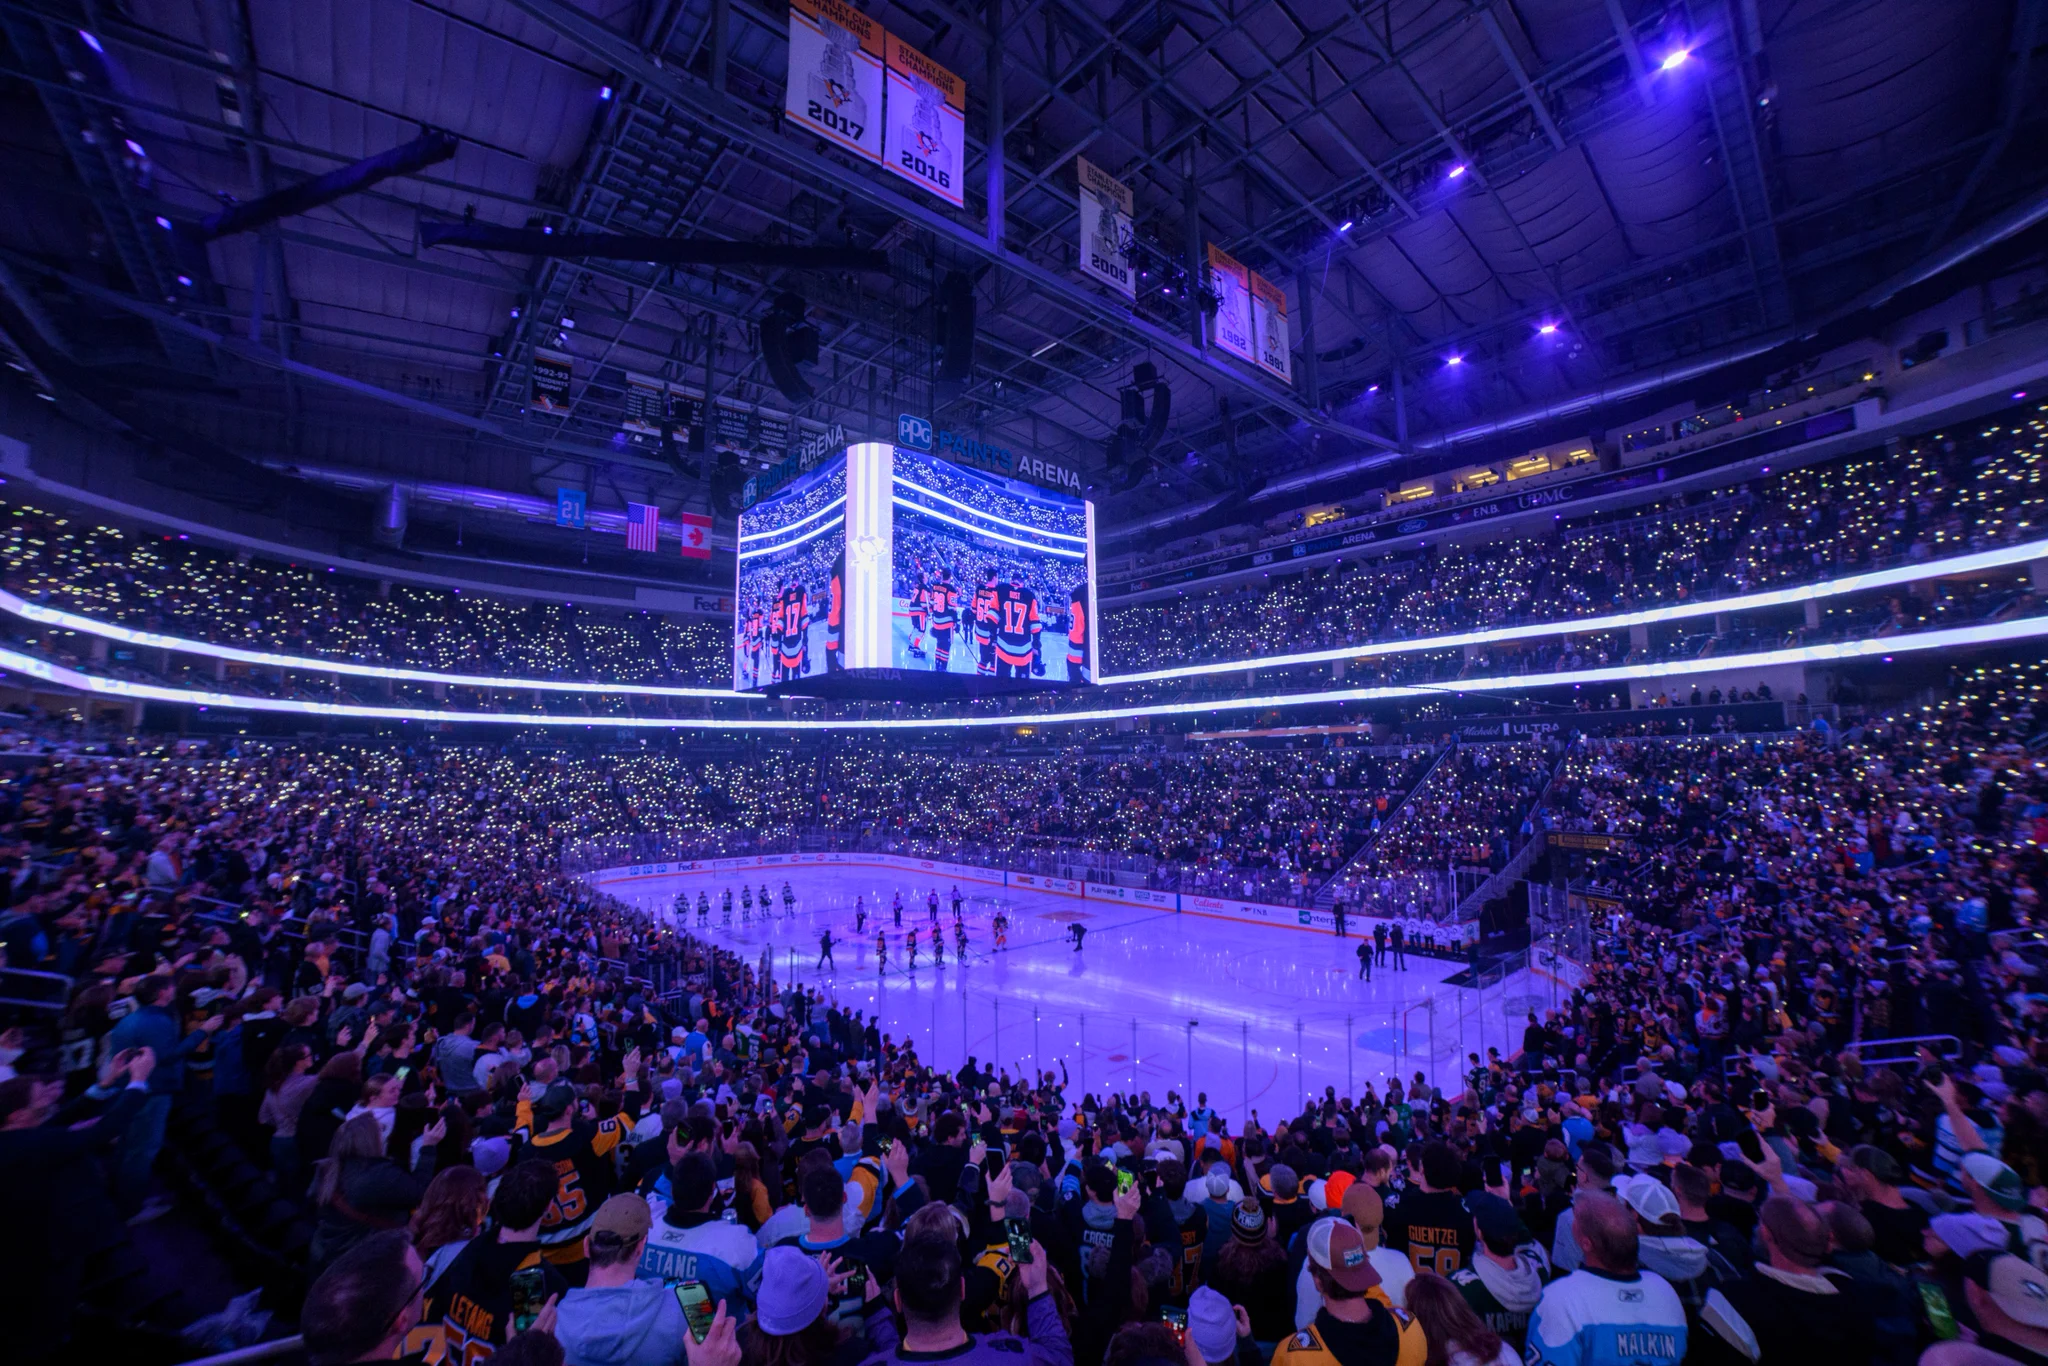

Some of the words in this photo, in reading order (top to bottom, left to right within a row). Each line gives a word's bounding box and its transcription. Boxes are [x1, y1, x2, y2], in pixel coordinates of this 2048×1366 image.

[852, 9, 871, 29] CUP
[899, 44, 936, 76] STANLEY
[938, 69, 955, 85] CUP
[899, 54, 954, 95] CHAMPIONS
[808, 100, 864, 141] 2017
[901, 151, 950, 189] 2016
[1092, 253, 1127, 284] 2009
[1222, 327, 1247, 350] 1992
[532, 365, 569, 380] 1992-93
[1264, 351, 1285, 373] 1991
[759, 455, 797, 493] PAINTS
[800, 424, 845, 468] ARENA
[939, 430, 1013, 470] PAINTS
[1018, 456, 1081, 490] ARENA
[562, 500, 580, 520] 21
[1518, 486, 1574, 509] UPMC
[1342, 531, 1376, 545] ARENA
[786, 602, 800, 637] 17
[1004, 601, 1027, 635] 17
[678, 862, 702, 871] FedEx
[1408, 1224, 1459, 1246] GUENTZEL
[641, 1247, 697, 1279] ETANG
[449, 1291, 495, 1341] LETANG
[1617, 1332, 1677, 1360] MALKIN
